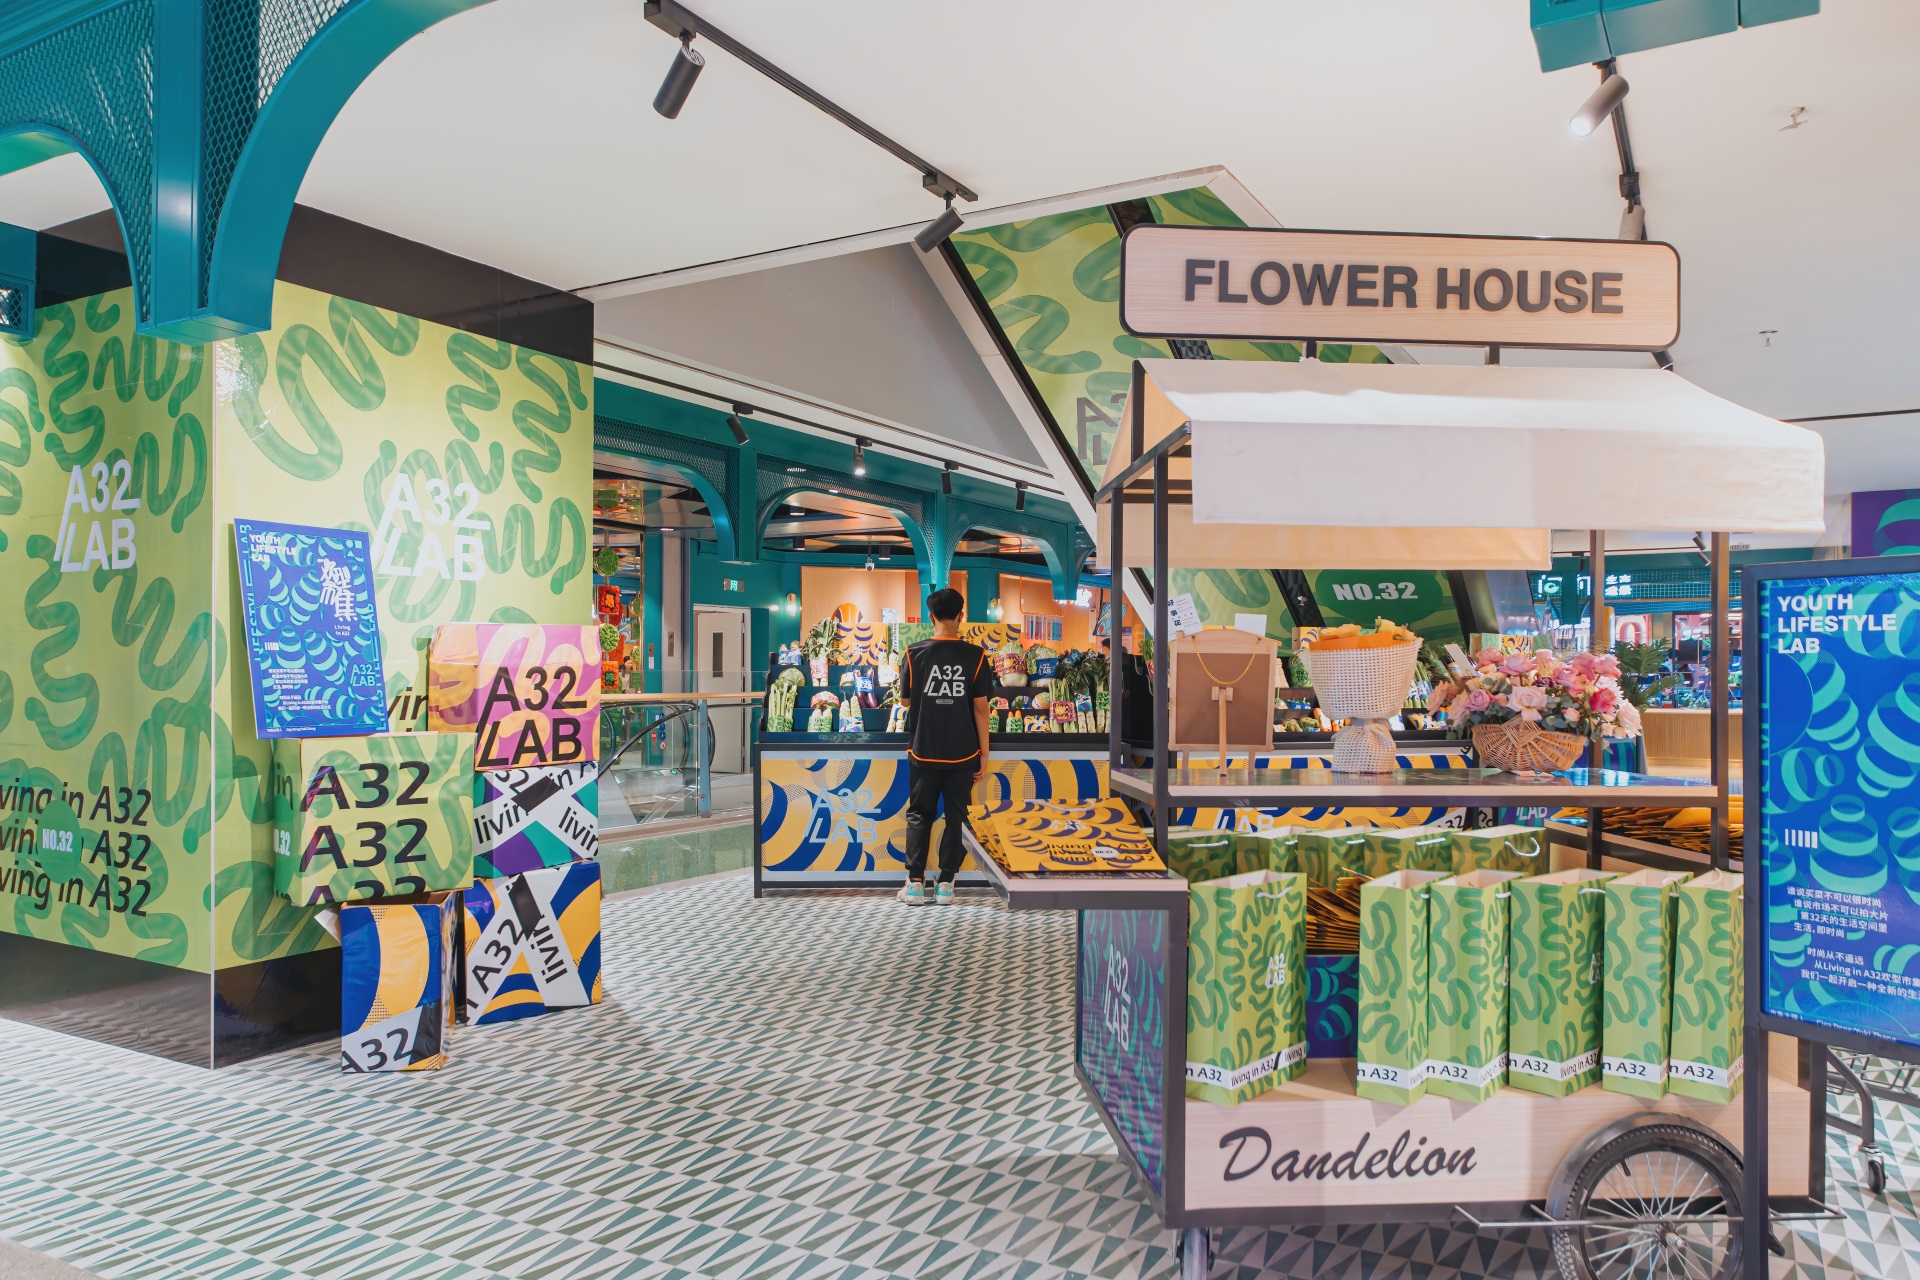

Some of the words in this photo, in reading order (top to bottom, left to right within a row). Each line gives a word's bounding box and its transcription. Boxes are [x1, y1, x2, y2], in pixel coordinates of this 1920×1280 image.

[1184, 259, 1419, 309] FLOWER
[1436, 267, 1624, 314] HOUSE
[54, 459, 141, 562] A32
[370, 472, 491, 564] A32
[60, 518, 137, 573] LAB
[249, 534, 281, 545] YOUTH
[251, 544, 298, 556] LIFESTYLE
[252, 553, 271, 563] LAB
[378, 527, 486, 581] LAB
[1332, 582, 1418, 601] NO.32
[1777, 594, 1853, 612] YOUTH
[1778, 614, 1897, 633] LIFESTYLE
[1778, 638, 1820, 654] LAB
[350, 664, 375, 684] A32
[352, 676, 376, 686] LAB
[924, 665, 965, 692] A32
[927, 681, 965, 697] LAB
[475, 666, 588, 750] A32
[478, 717, 582, 768] LAB
[299, 761, 429, 813] A32
[89, 785, 152, 827] A32
[803, 787, 881, 837] A32
[42, 829, 73, 854] NO.32
[809, 817, 878, 843] LAB
[89, 829, 151, 872] A32
[299, 818, 428, 873] A32
[88, 873, 151, 917] A32
[1787, 886, 1882, 908] 谁说买菜不可以很时尚
[1794, 898, 1888, 921] 谁说市场不可以拍大片
[1800, 911, 1888, 934] 第32天的生活空间里
[472, 918, 526, 995] A32
[1807, 946, 1864, 965] 时尚从不遥远
[1104, 943, 1131, 1014] A32
[1265, 953, 1286, 987] A32
[1266, 969, 1285, 989] LAB
[1800, 968, 1920, 1000] 我们一起开启一种全新的生
[1105, 988, 1130, 1052] LAB
[1198, 1067, 1222, 1082] A32
[1369, 1065, 1398, 1082] A32
[1440, 1065, 1468, 1080] A32
[1521, 1059, 1549, 1074] A32
[1616, 1062, 1646, 1077] A32
[1683, 1065, 1714, 1081] A32
[1219, 1126, 1478, 1182] Dandelion
